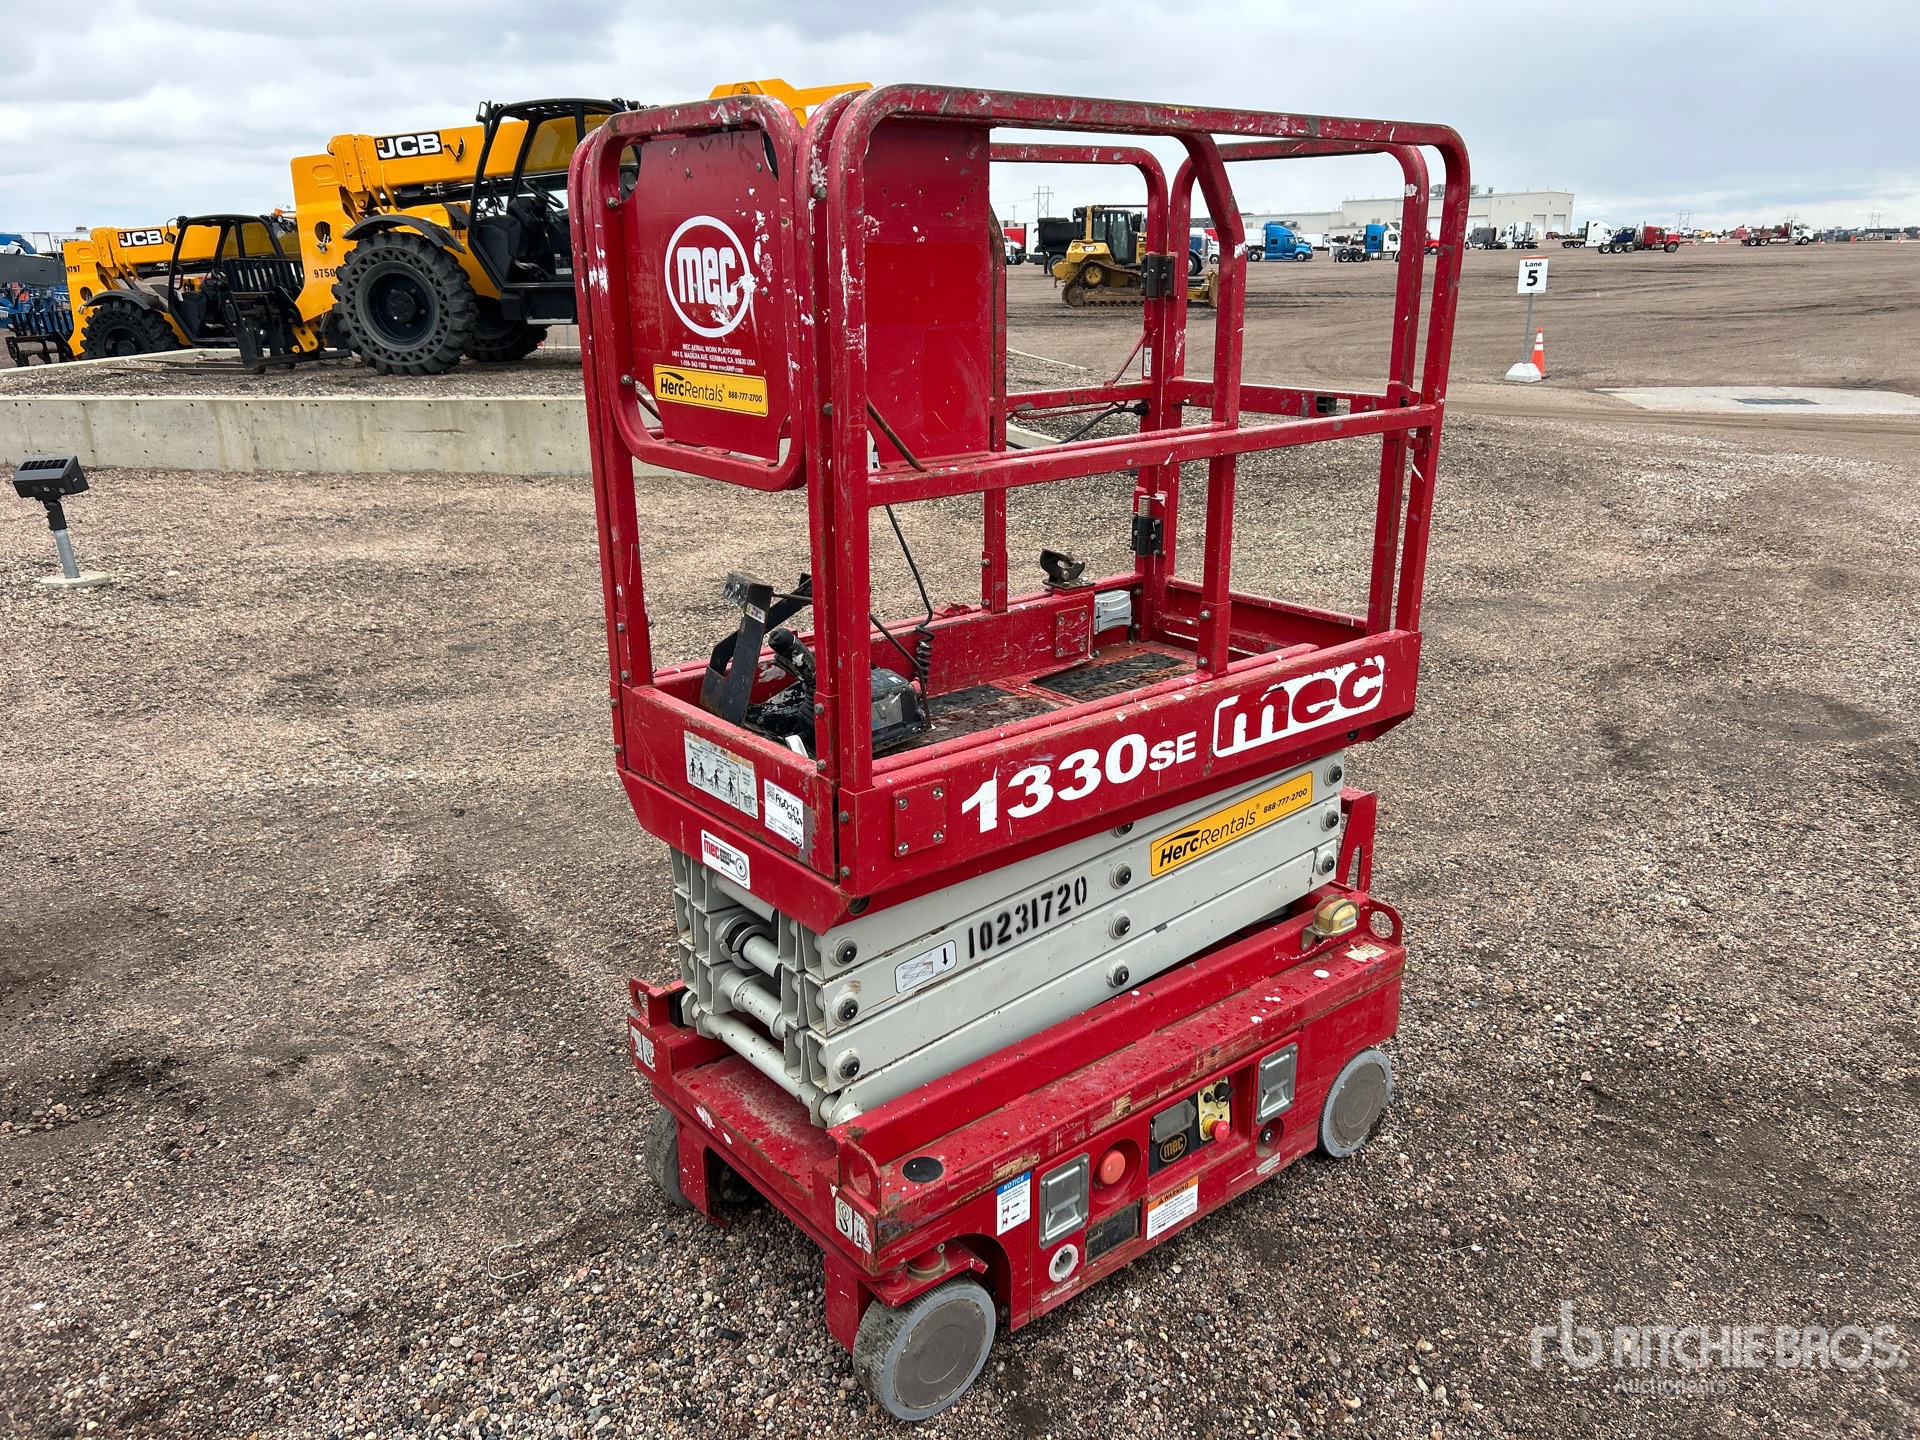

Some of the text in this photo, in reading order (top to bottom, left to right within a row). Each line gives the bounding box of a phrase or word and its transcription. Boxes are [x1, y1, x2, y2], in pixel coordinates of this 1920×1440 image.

[378, 133, 442, 159] JCB
[120, 230, 163, 247] JCB
[314, 268, 336, 278] 9750
[1526, 269, 1538, 287] 5
[682, 343, 742, 356] MEC AERIAL WORK PLATFORMS
[728, 390, 763, 403] 888-777-2700
[1263, 787, 1308, 814] 888-777-2700
[968, 876, 1087, 959] 10231720
[1003, 1174, 1025, 1192] NOTICE
[1164, 1183, 1189, 1202] WARNING
